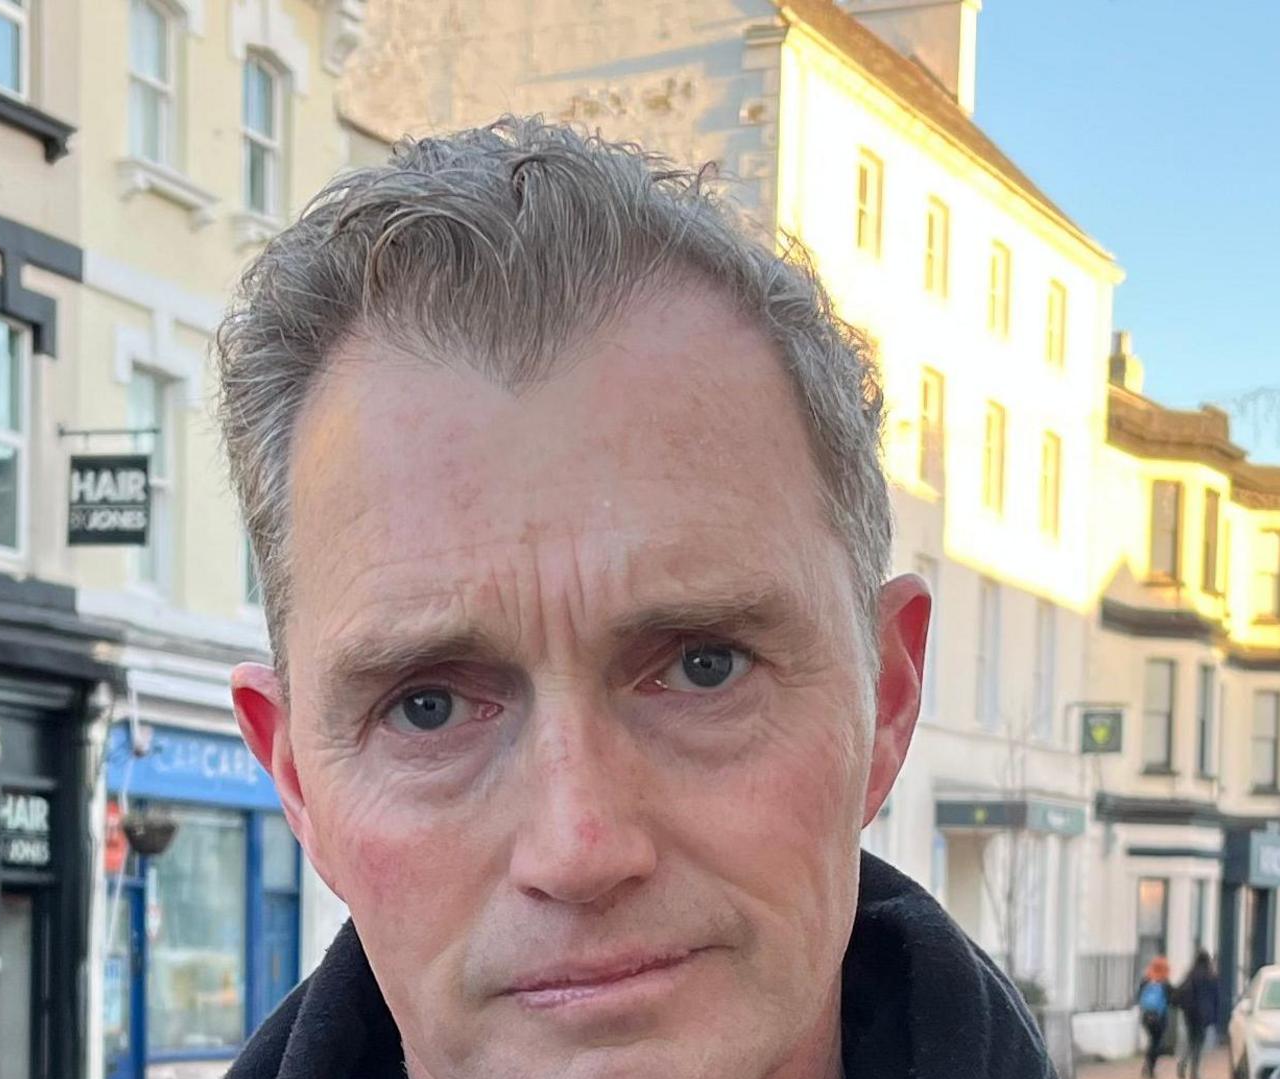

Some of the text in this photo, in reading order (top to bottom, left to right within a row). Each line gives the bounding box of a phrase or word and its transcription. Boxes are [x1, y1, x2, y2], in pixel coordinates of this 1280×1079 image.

[71, 469, 147, 502] HAIR
[87, 510, 147, 530] JONES
[0, 793, 49, 831] HAIR
[10, 840, 50, 864] JONES
